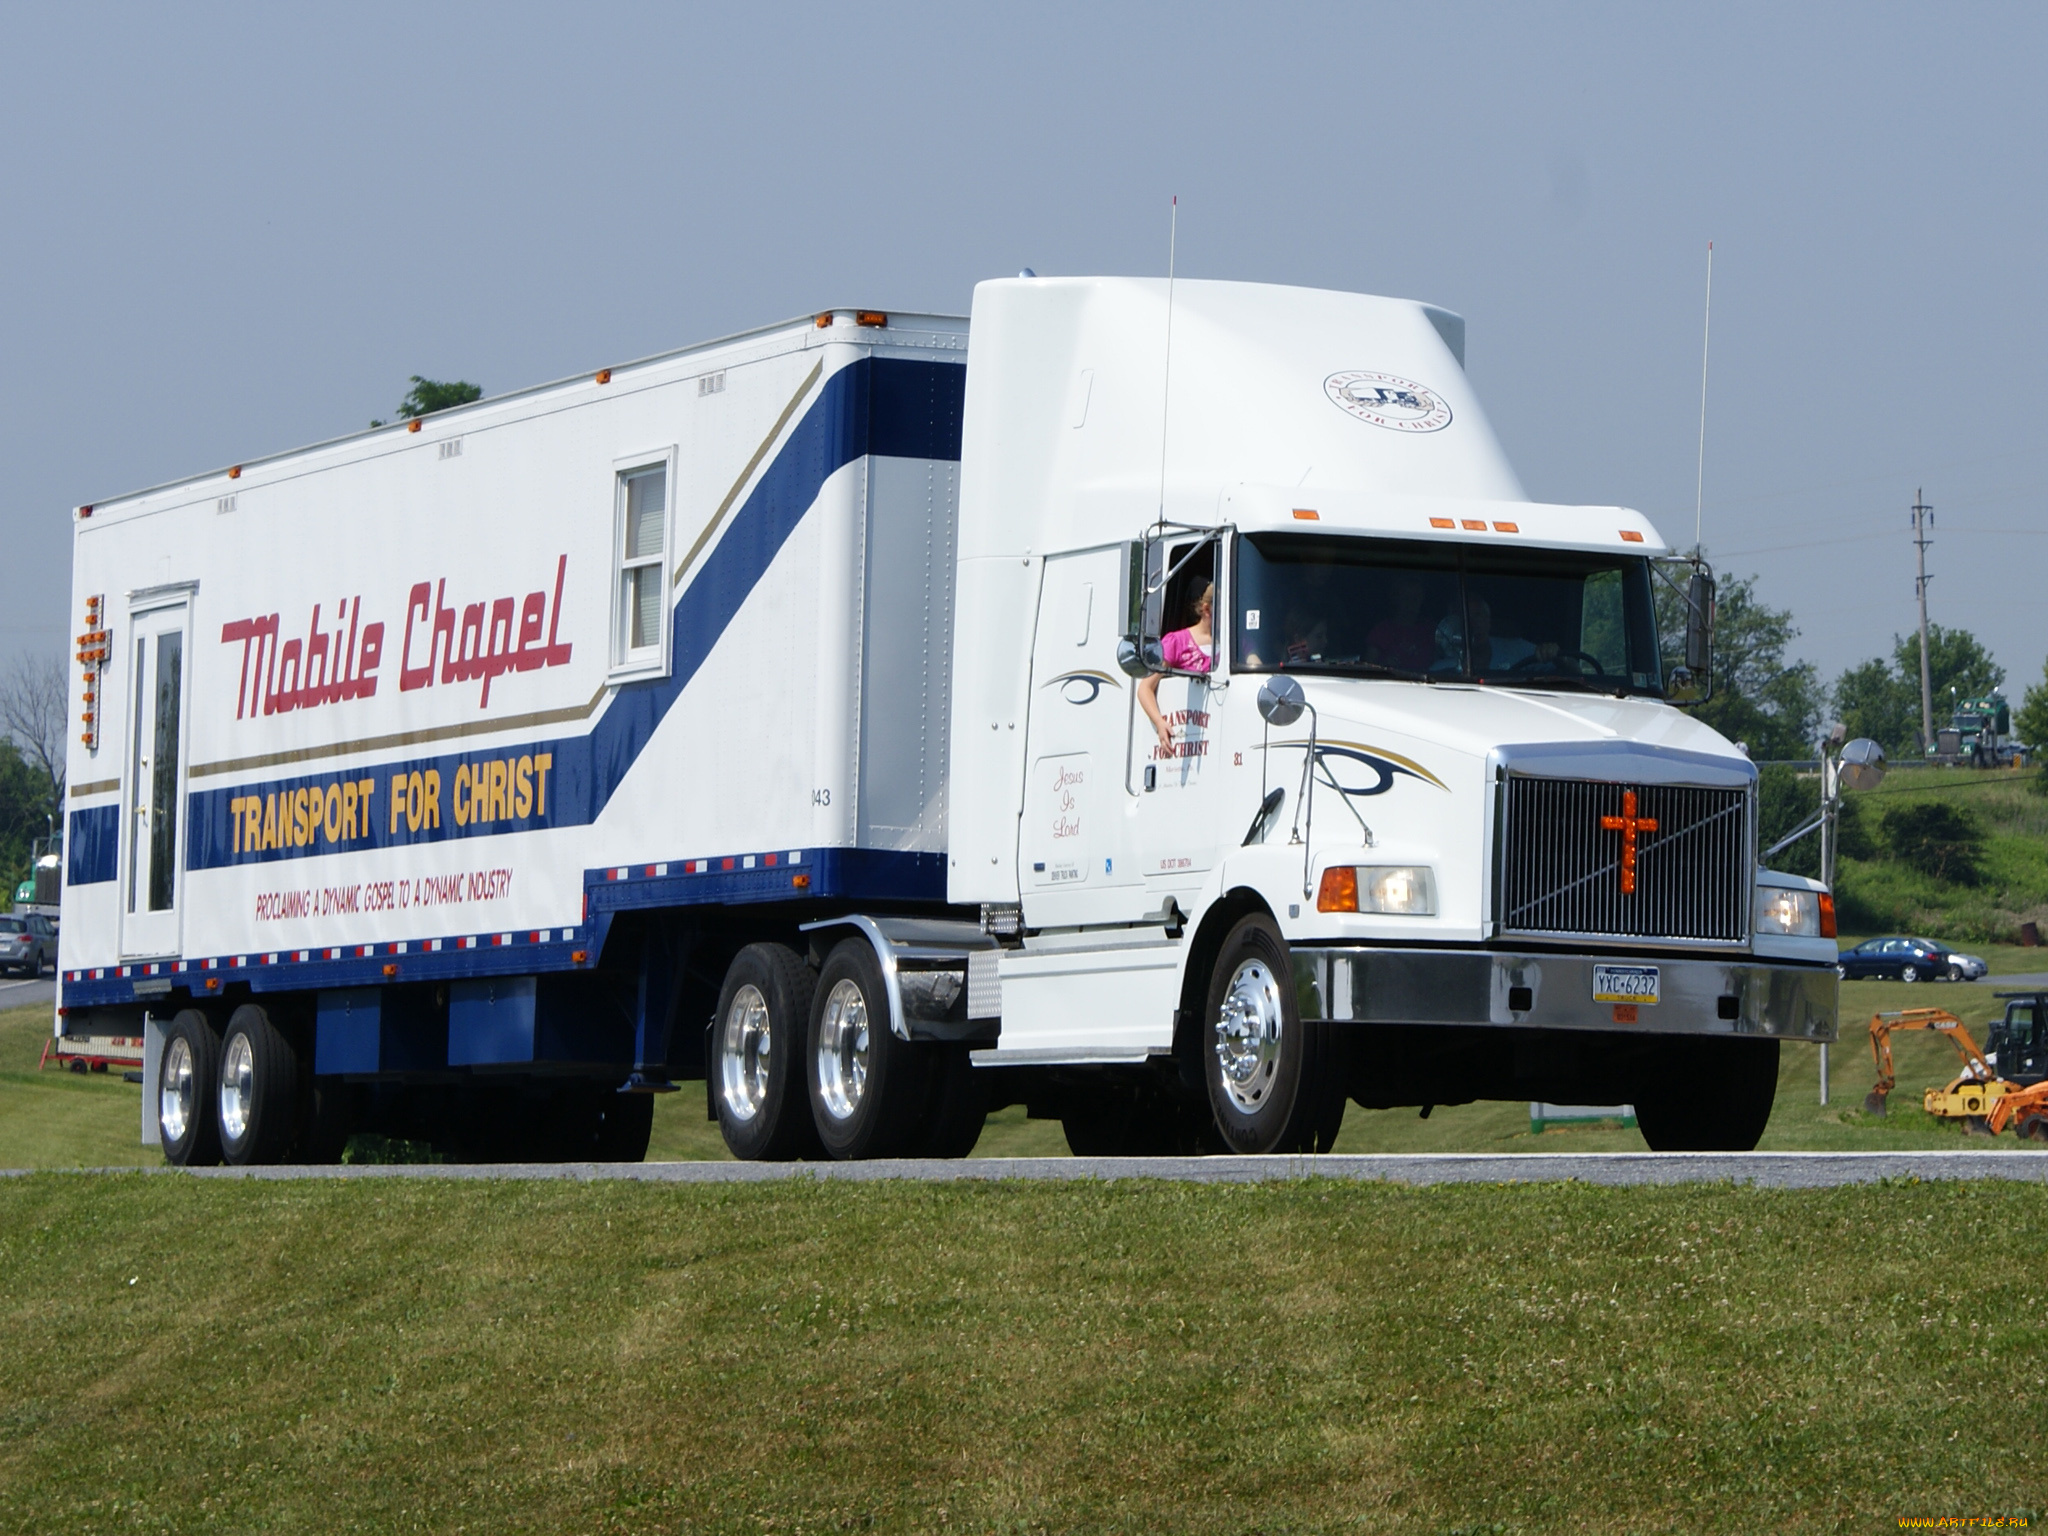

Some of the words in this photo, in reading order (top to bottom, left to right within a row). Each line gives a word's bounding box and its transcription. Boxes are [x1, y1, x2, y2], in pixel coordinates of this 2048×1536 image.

[221, 595, 385, 720] Mobile
[400, 553, 573, 709] Chapel
[1162, 709, 1211, 729] RANSPORT
[1174, 740, 1209, 758] CHRIST
[1053, 766, 1083, 792] Jesus
[231, 778, 375, 854] TRANSPORT
[390, 768, 440, 835] FOR
[453, 753, 553, 827] CHRIST
[1060, 789, 1075, 812] Is
[1053, 816, 1080, 839] Lord
[256, 890, 310, 921] PROCLAIMING
[313, 889, 319, 917] A
[322, 884, 361, 917] DYNAMIC
[364, 881, 395, 912] GOSPEL
[399, 879, 410, 909] TO
[414, 878, 420, 907] A
[423, 873, 464, 906] DYNAMIC
[467, 868, 513, 902] INDUSTRY
